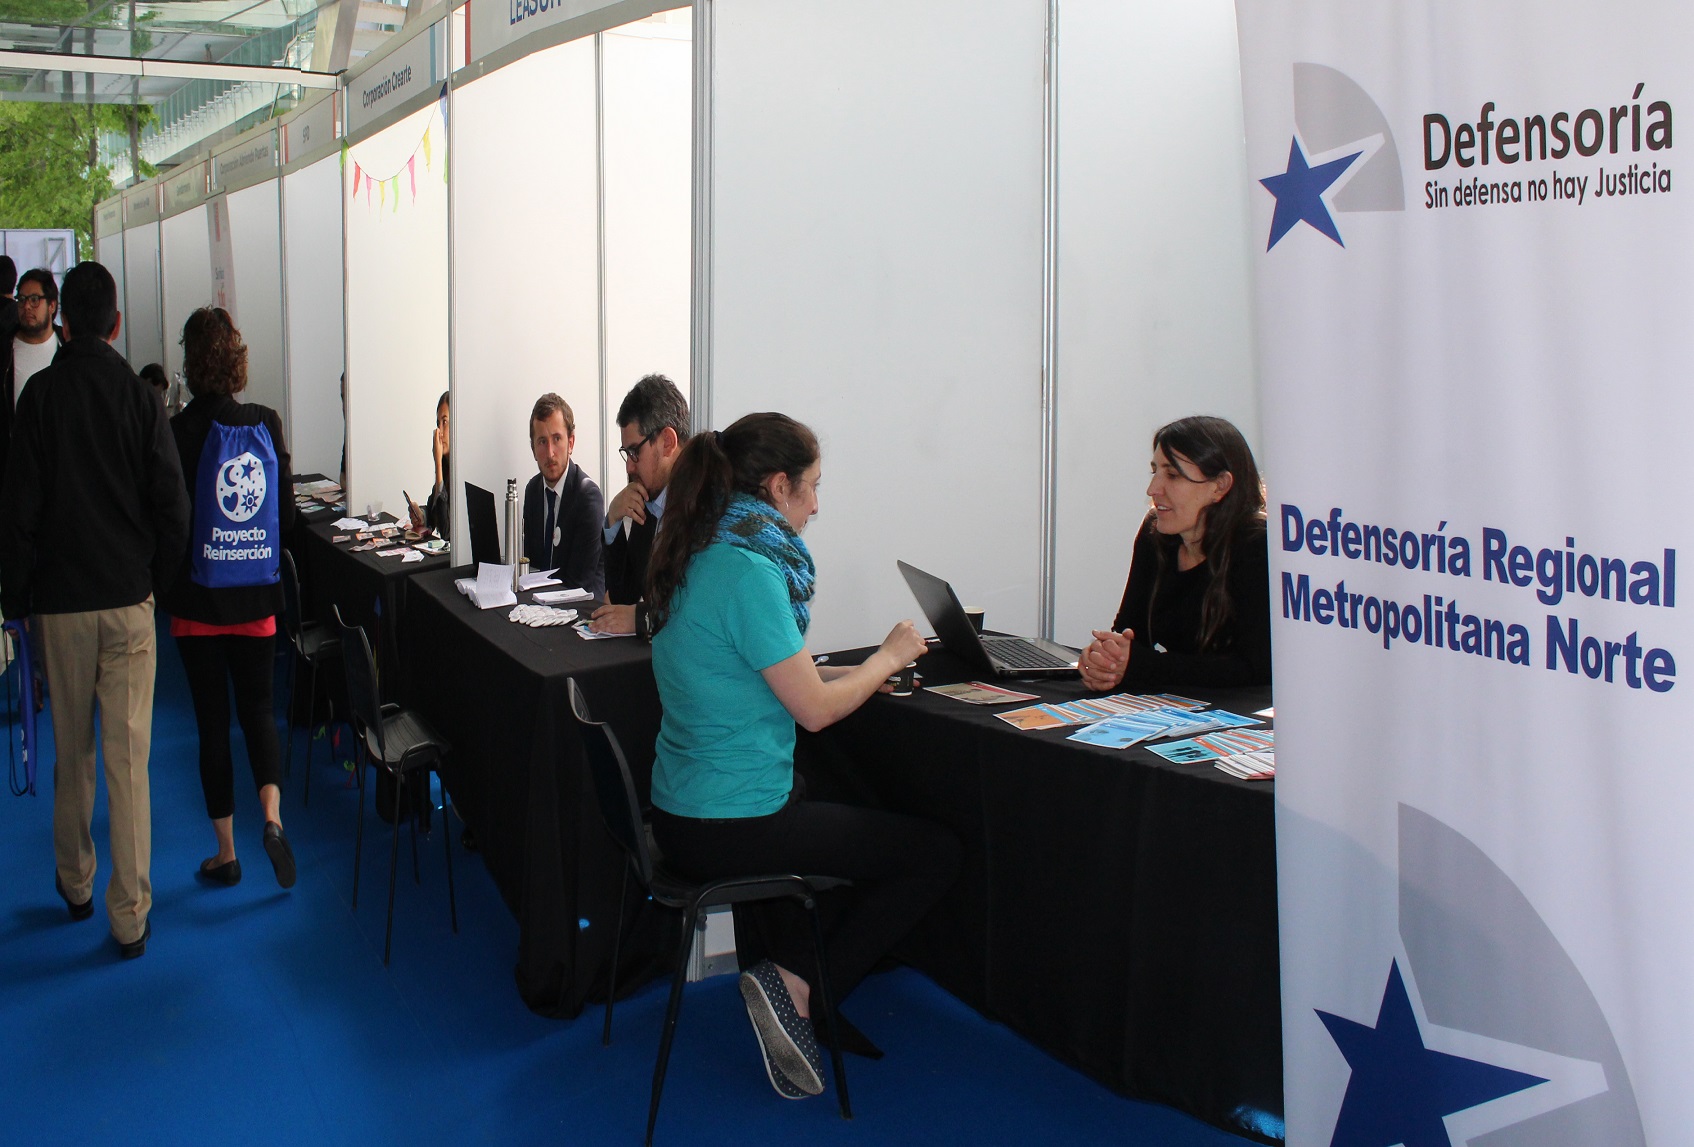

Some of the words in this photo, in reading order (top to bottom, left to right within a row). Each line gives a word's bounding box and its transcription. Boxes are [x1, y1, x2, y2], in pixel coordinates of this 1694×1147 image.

[510, 0, 561, 25] LEAS
[362, 75, 391, 108] Corporación
[392, 64, 412, 91] Crearte
[1423, 82, 1673, 170] Defensoría
[1425, 181, 1448, 209] Sin
[1453, 177, 1521, 207] defensa
[1528, 178, 1548, 202] no
[1553, 170, 1589, 206] hay
[1594, 162, 1671, 198] Justicia
[203, 544, 272, 561] Reinserción
[212, 526, 266, 545] Proyecto
[1281, 504, 1471, 578] Defensoría
[1482, 527, 1676, 608] Regional
[1281, 571, 1530, 666] Metropolitana
[1546, 615, 1676, 693] Norte
